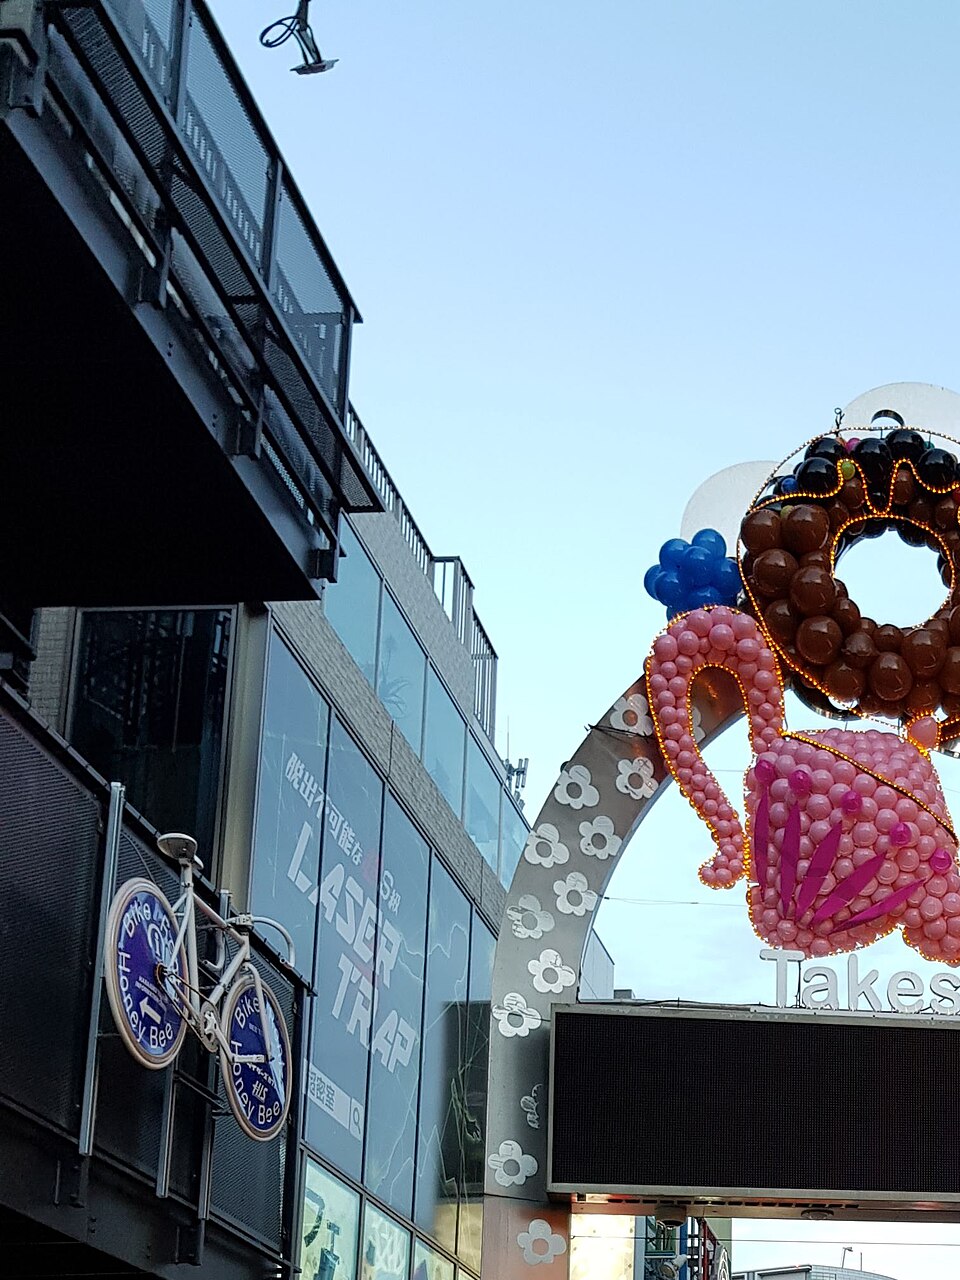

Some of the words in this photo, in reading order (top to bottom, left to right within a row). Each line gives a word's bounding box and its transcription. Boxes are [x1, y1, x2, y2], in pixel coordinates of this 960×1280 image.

[123, 901, 151, 938] Bike
[287, 820, 402, 989] LASER
[118, 951, 147, 1042] Honey
[150, 1022, 173, 1049] Bee
[234, 997, 260, 1029] Bike
[331, 953, 416, 1074] TRAP
[258, 1101, 280, 1125] Bee
